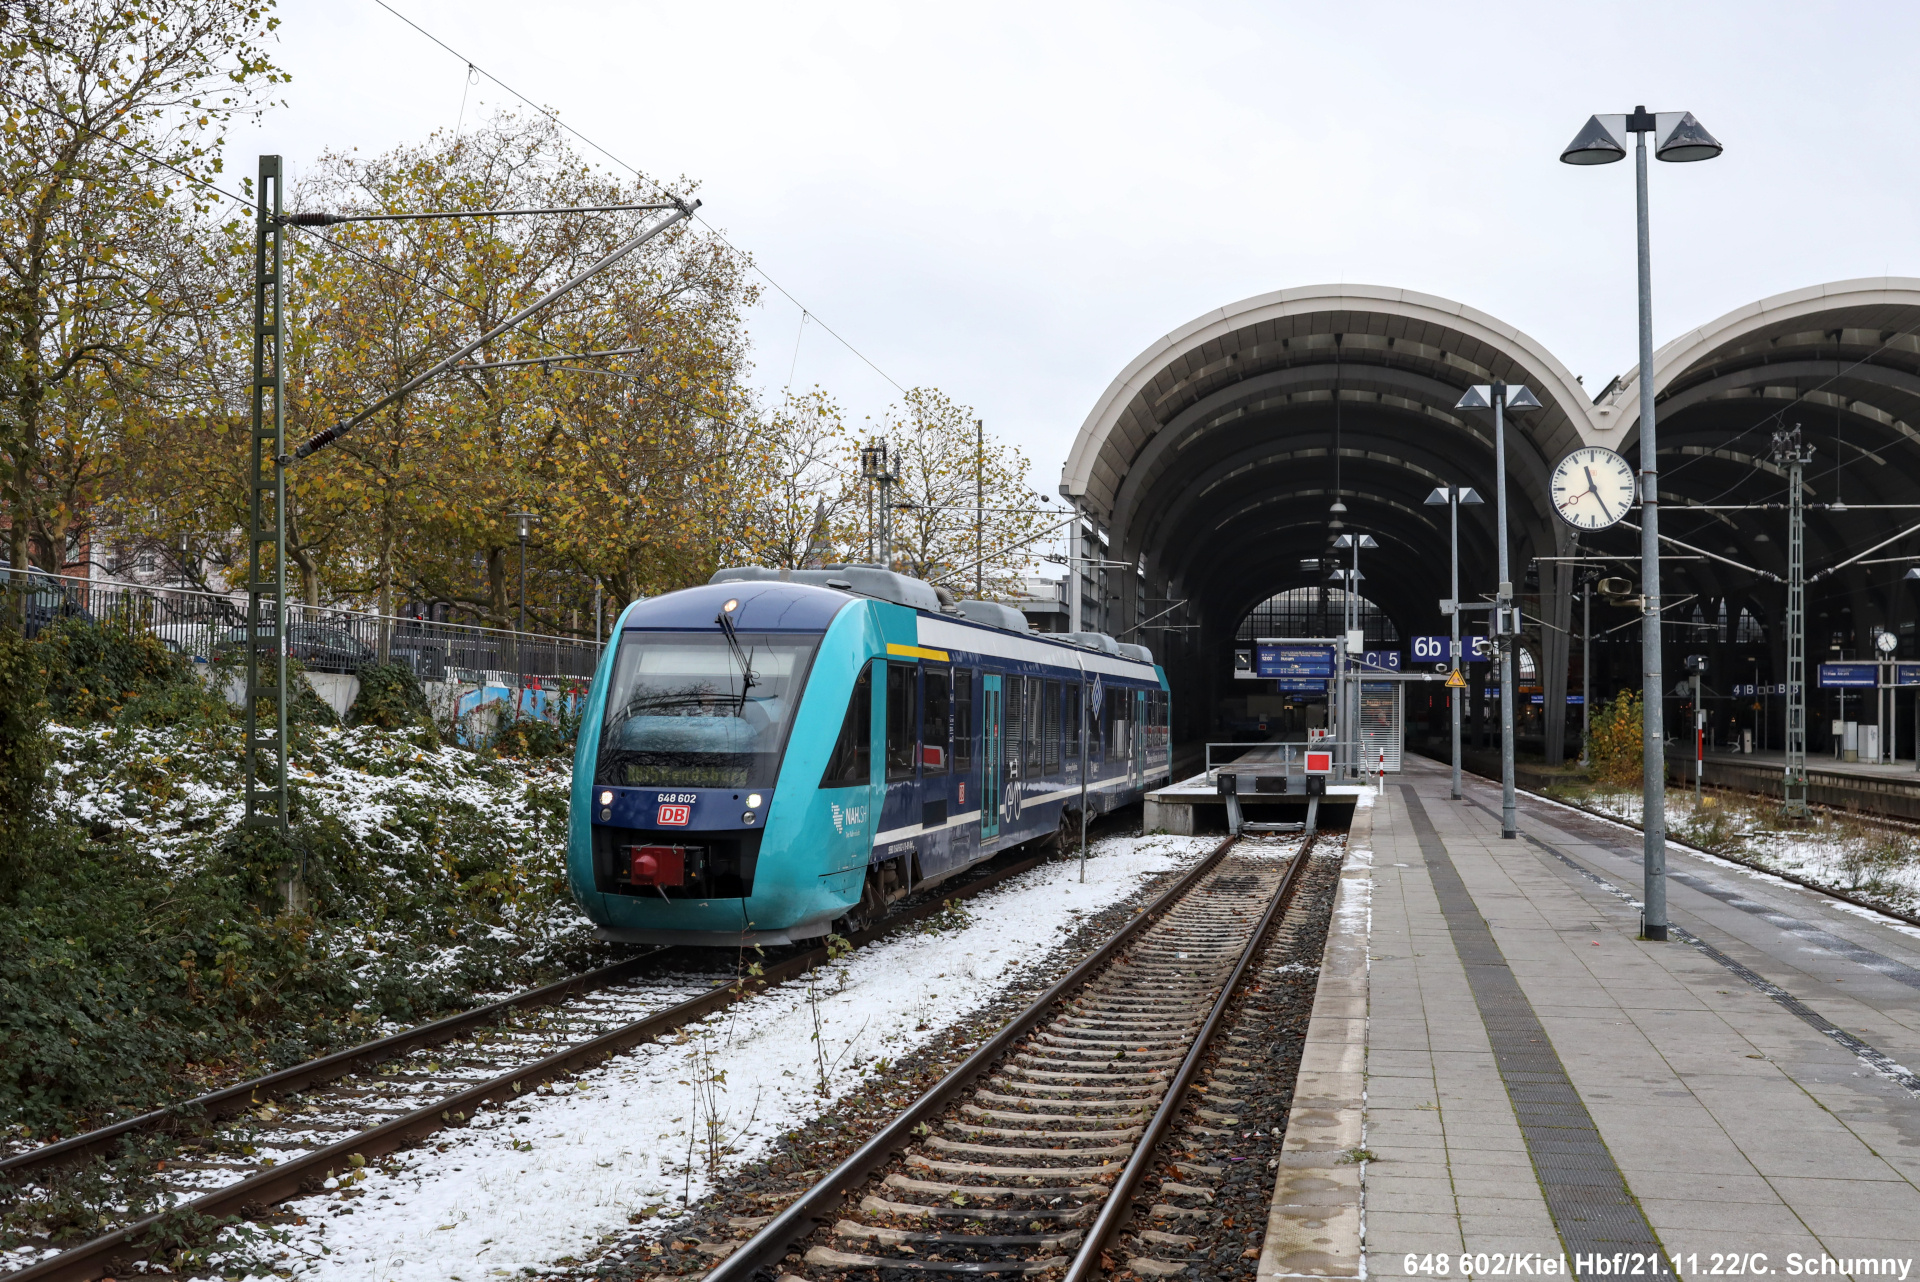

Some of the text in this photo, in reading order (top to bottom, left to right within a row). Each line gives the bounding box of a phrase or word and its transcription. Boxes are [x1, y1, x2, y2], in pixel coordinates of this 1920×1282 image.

[1414, 636, 1442, 657] 6b
[1366, 652, 1398, 667] C 5
[1746, 684, 1754, 695] B
[1778, 683, 1786, 694] B
[657, 793, 697, 804] 648 602
[660, 807, 687, 823] DB
